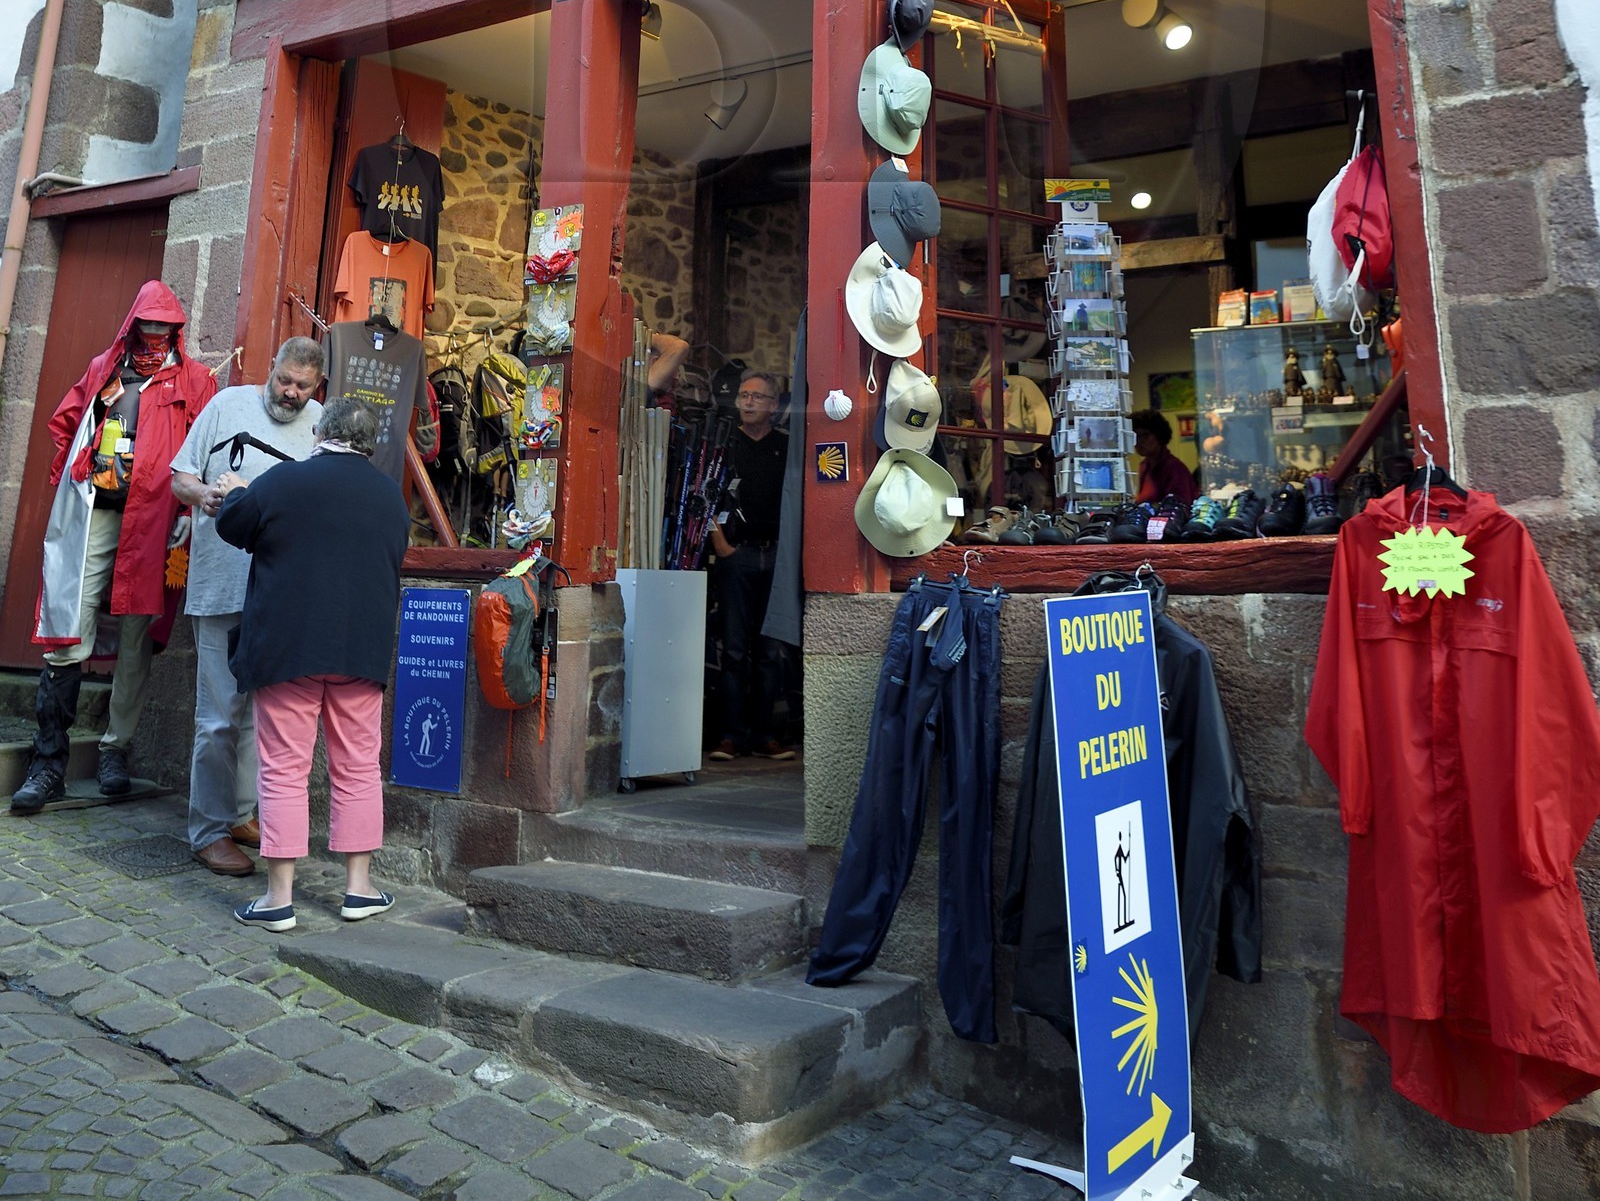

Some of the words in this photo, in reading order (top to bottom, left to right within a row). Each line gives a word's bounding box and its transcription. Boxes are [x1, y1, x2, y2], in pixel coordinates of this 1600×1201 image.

[408, 600, 462, 611] EQUIPEMENTS
[404, 611, 415, 620] DE
[417, 612, 465, 623] RANDONNEE
[1059, 609, 1145, 656] BOUTIQUE
[410, 634, 455, 646] SOUVENIRS
[398, 656, 426, 666] GUIDES
[428, 659, 436, 667] et
[437, 659, 464, 670] LIVRES
[410, 668, 420, 677] du
[421, 669, 451, 679] CHEMIN
[1095, 671, 1122, 711] DU
[432, 698, 442, 708] DU
[404, 696, 431, 730] BOUTIQUE
[441, 707, 452, 751] PELERIN
[404, 733, 410, 746] LA
[1078, 724, 1148, 780] PELERIN
